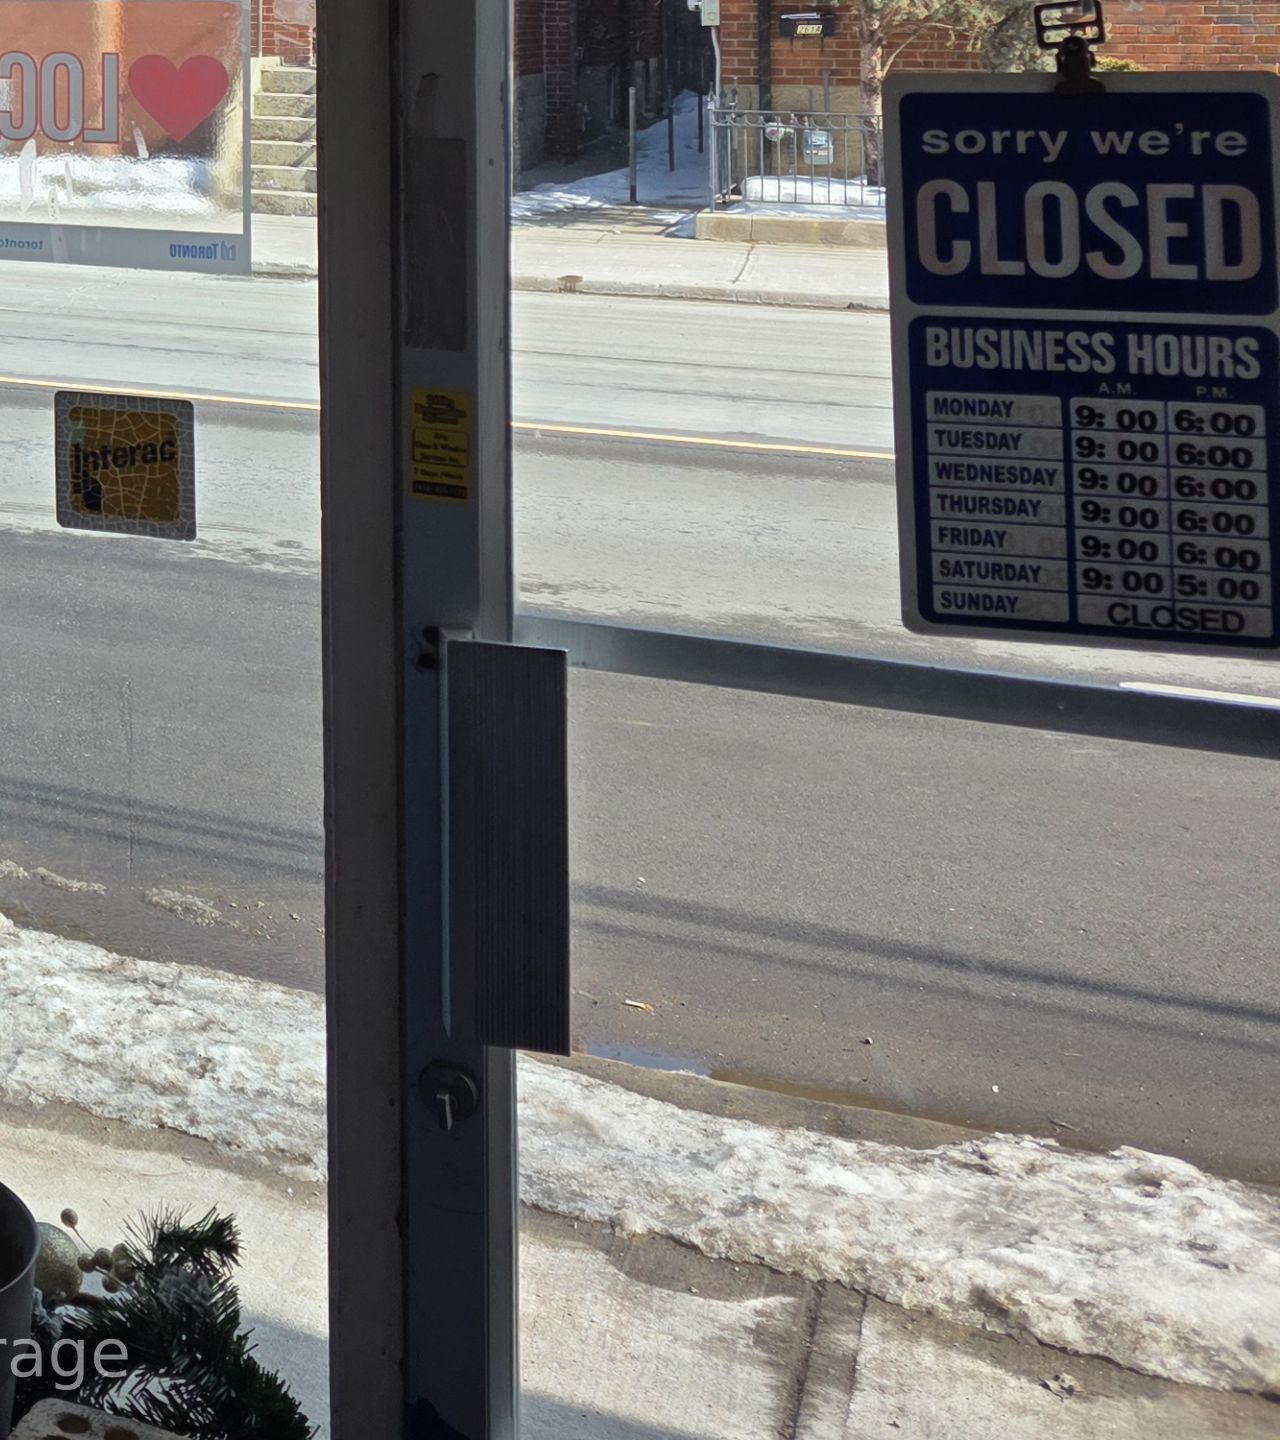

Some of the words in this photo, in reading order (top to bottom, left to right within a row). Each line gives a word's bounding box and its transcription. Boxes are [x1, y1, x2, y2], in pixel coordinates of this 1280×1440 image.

[921, 129, 1069, 162] sorry
[1091, 122, 1248, 156] we're
[915, 178, 1263, 282] CLOSED
[925, 327, 1115, 374] BUSINESS
[1129, 335, 1260, 380] HOURS
[1098, 383, 1137, 397] A.M.
[1196, 386, 1234, 400] P.M.
[933, 398, 1014, 418] MONDAY
[934, 430, 1022, 452] TUESDAY
[72, 440, 176, 474] Interac
[935, 463, 1058, 487] WEDNESDAY
[936, 494, 1042, 519] THURSDAY
[938, 527, 1007, 551] FRIDAY
[939, 560, 1042, 584] SATURDAY
[940, 591, 1019, 614] SUNDAY
[1107, 602, 1245, 634] CLOSED
